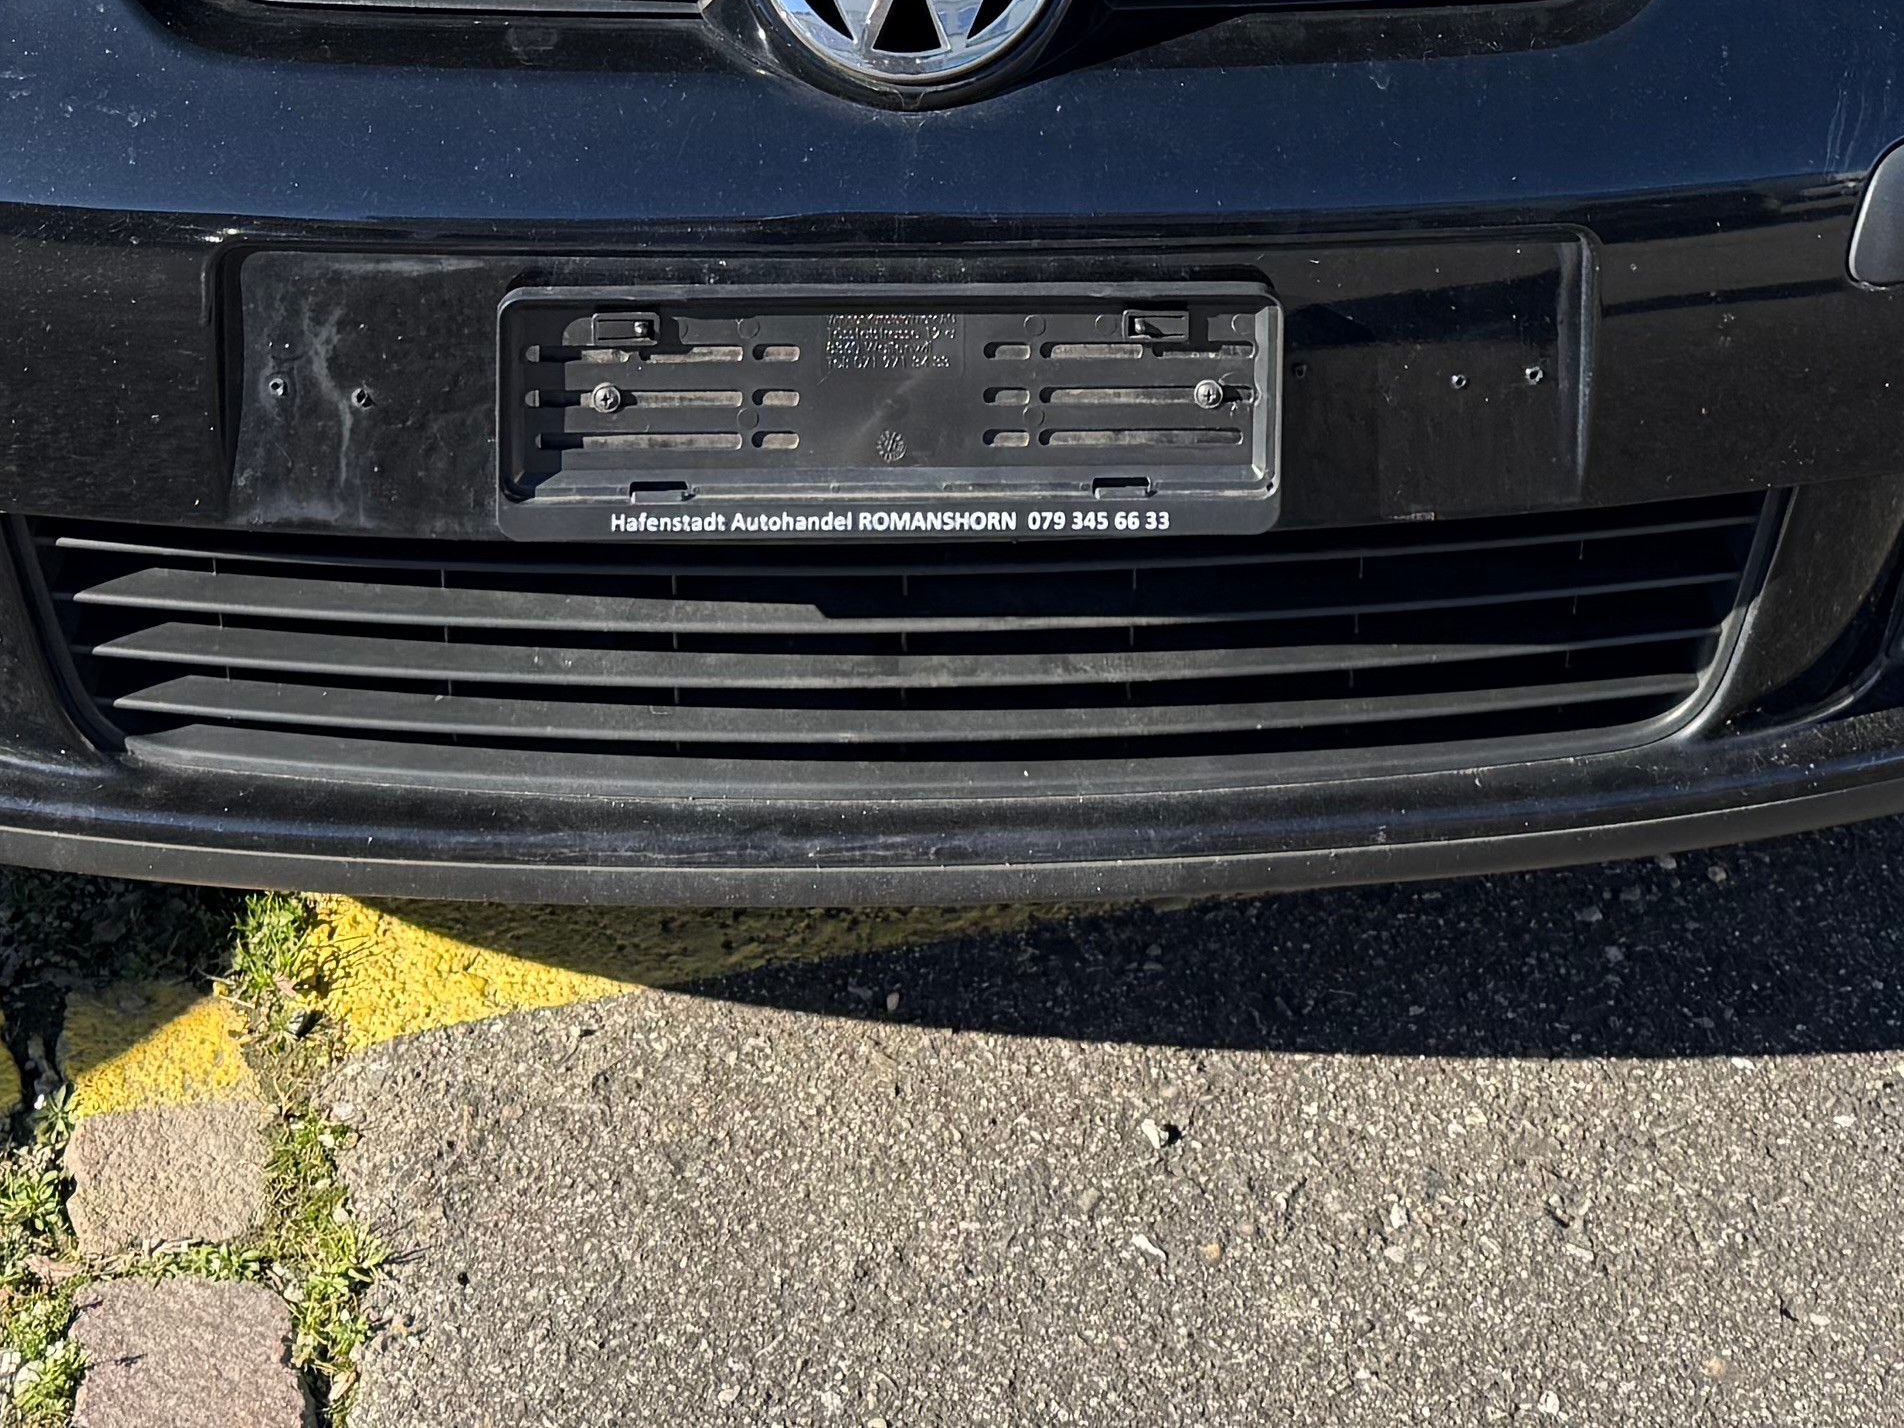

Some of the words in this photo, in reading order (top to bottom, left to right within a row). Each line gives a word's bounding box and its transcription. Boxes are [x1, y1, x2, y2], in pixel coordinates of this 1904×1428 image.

[610, 511, 726, 533] Hafenstadt
[730, 511, 852, 532] Autohandel
[858, 511, 1018, 531] ROMANSHORN
[1027, 511, 1066, 531] 079
[1071, 511, 1109, 531] 345
[1114, 511, 1140, 531] 66
[1145, 511, 1171, 530] 33
